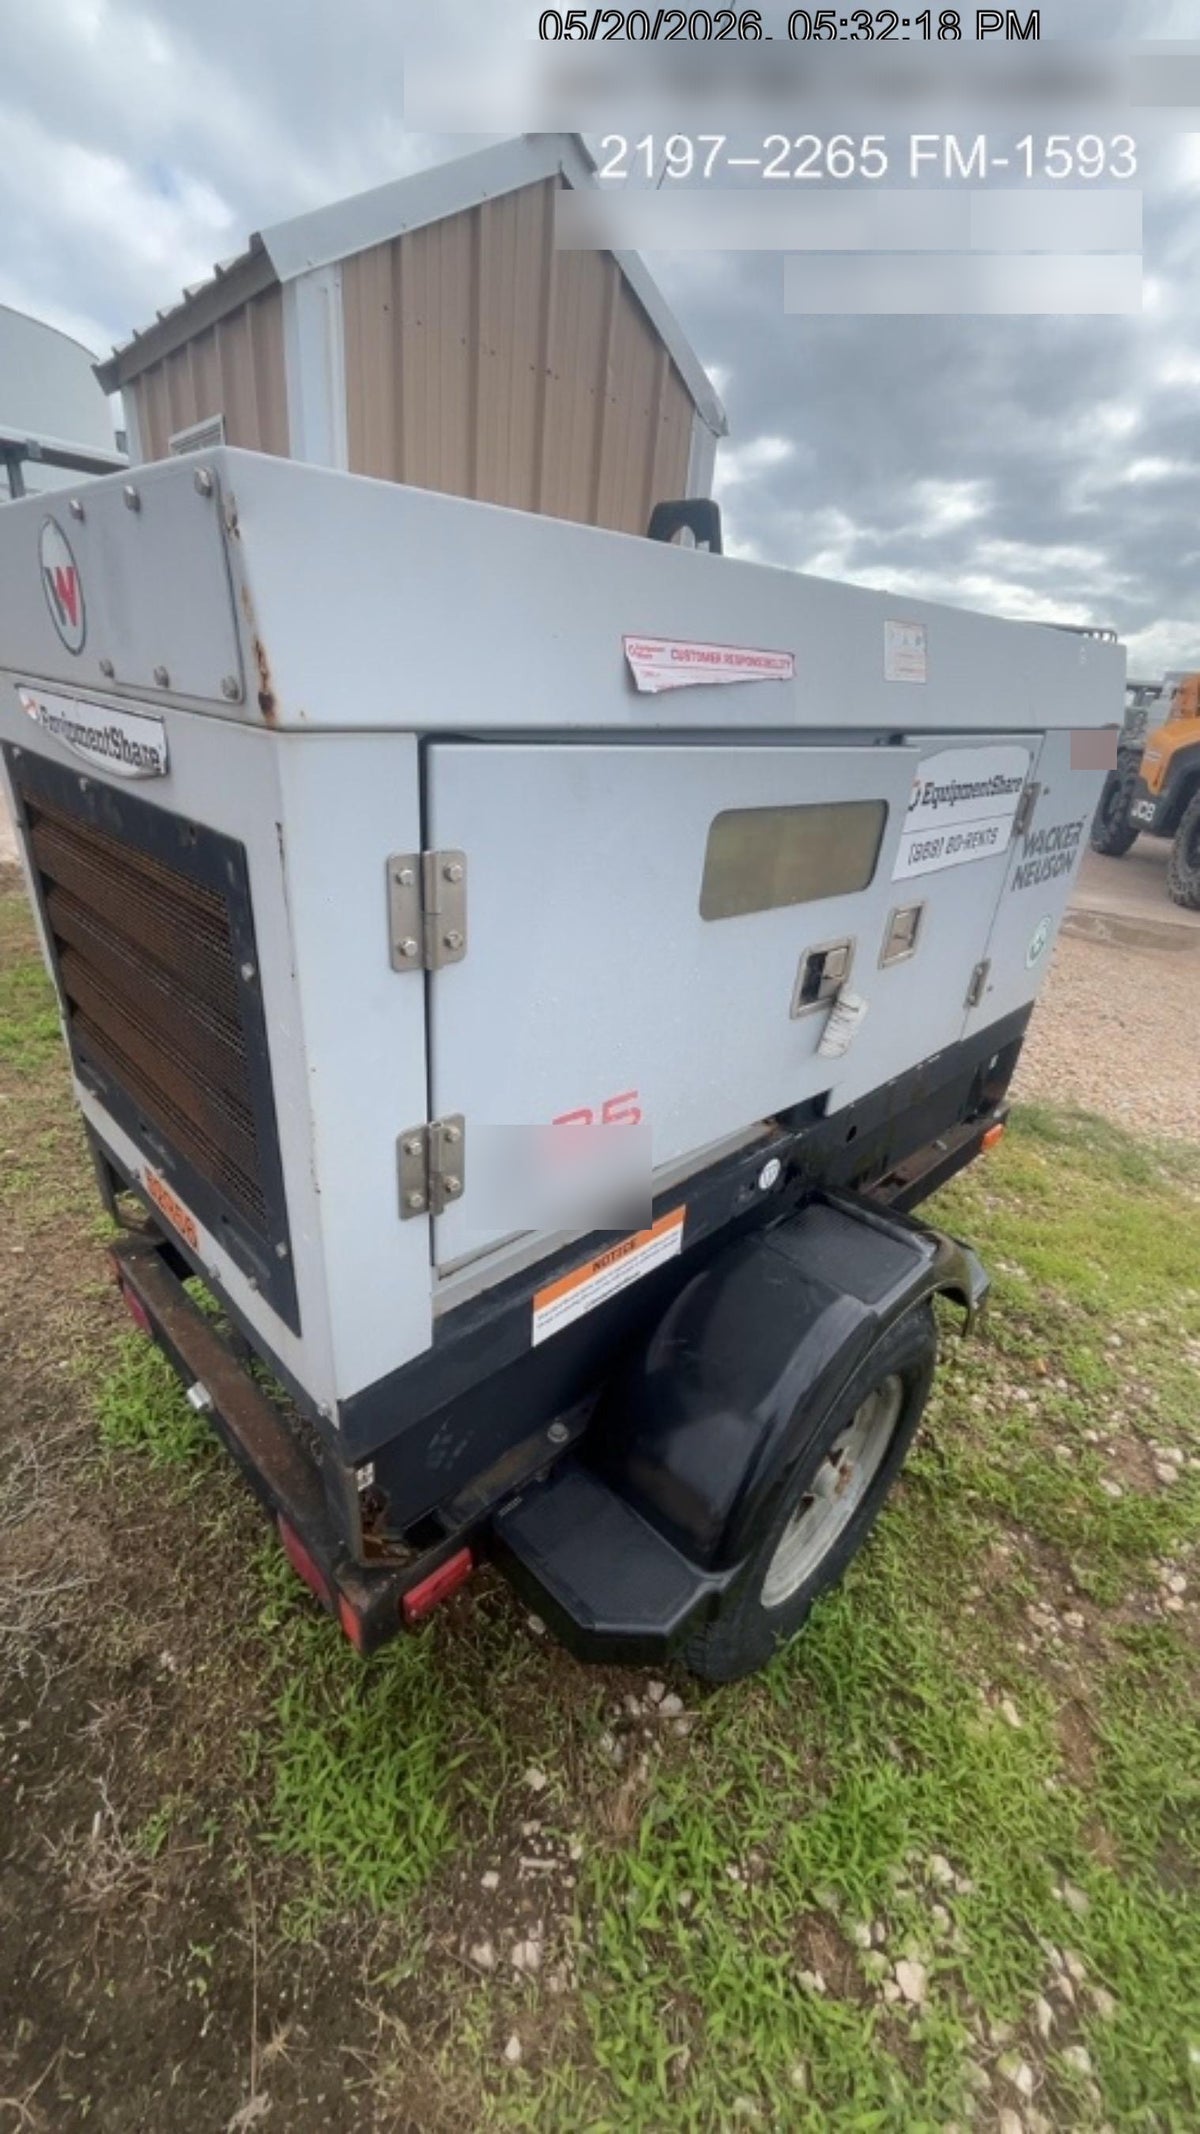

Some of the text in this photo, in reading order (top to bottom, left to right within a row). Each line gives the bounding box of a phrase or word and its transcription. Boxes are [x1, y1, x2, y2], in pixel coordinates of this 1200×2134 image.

[1022, 822, 1084, 860] WACKER
[1011, 850, 1078, 892] NEUSON
[592, 1239, 638, 1273] NOTICE
